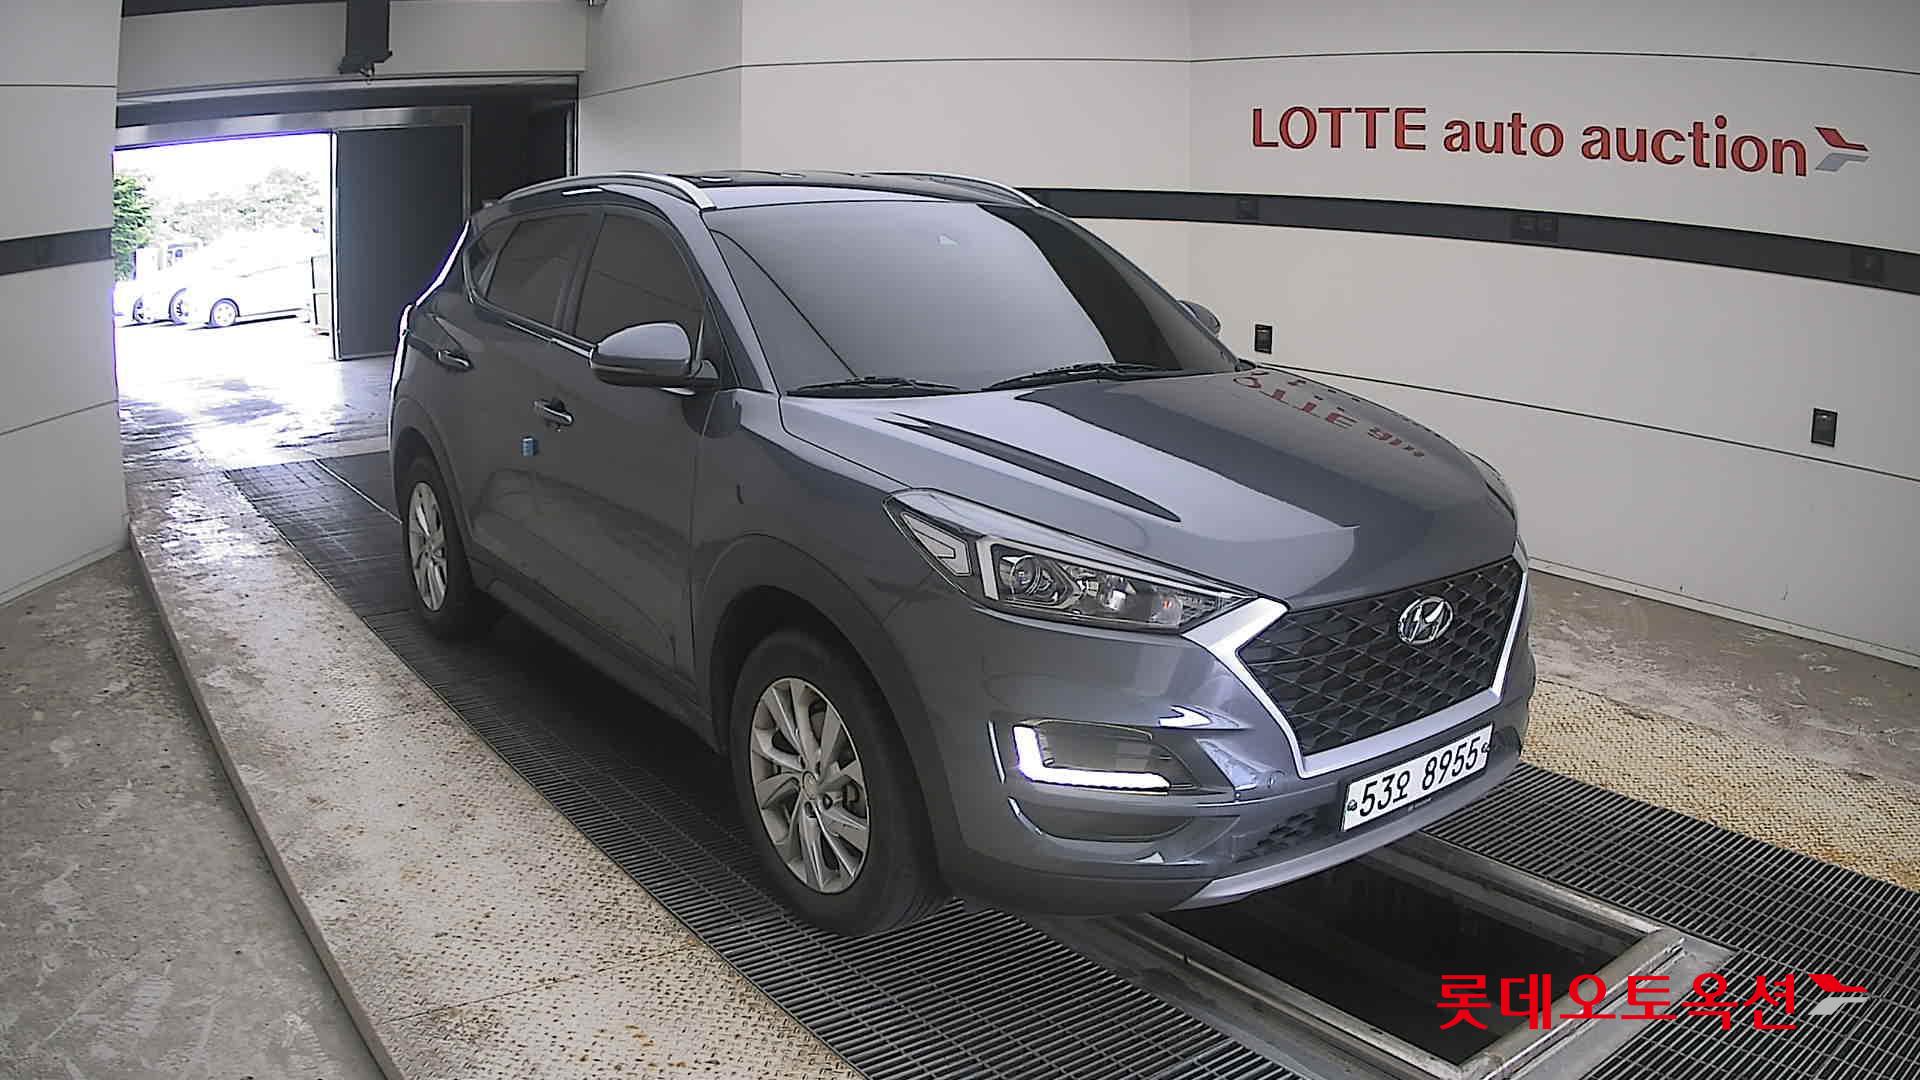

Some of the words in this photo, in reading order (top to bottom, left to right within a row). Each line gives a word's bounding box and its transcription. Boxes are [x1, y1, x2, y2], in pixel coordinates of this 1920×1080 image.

[1252, 106, 1427, 151] LOTTE
[1443, 113, 1564, 158] auto
[1580, 116, 1808, 177] auction
[1359, 770, 1411, 817] 53오
[1421, 735, 1481, 791] 8955
